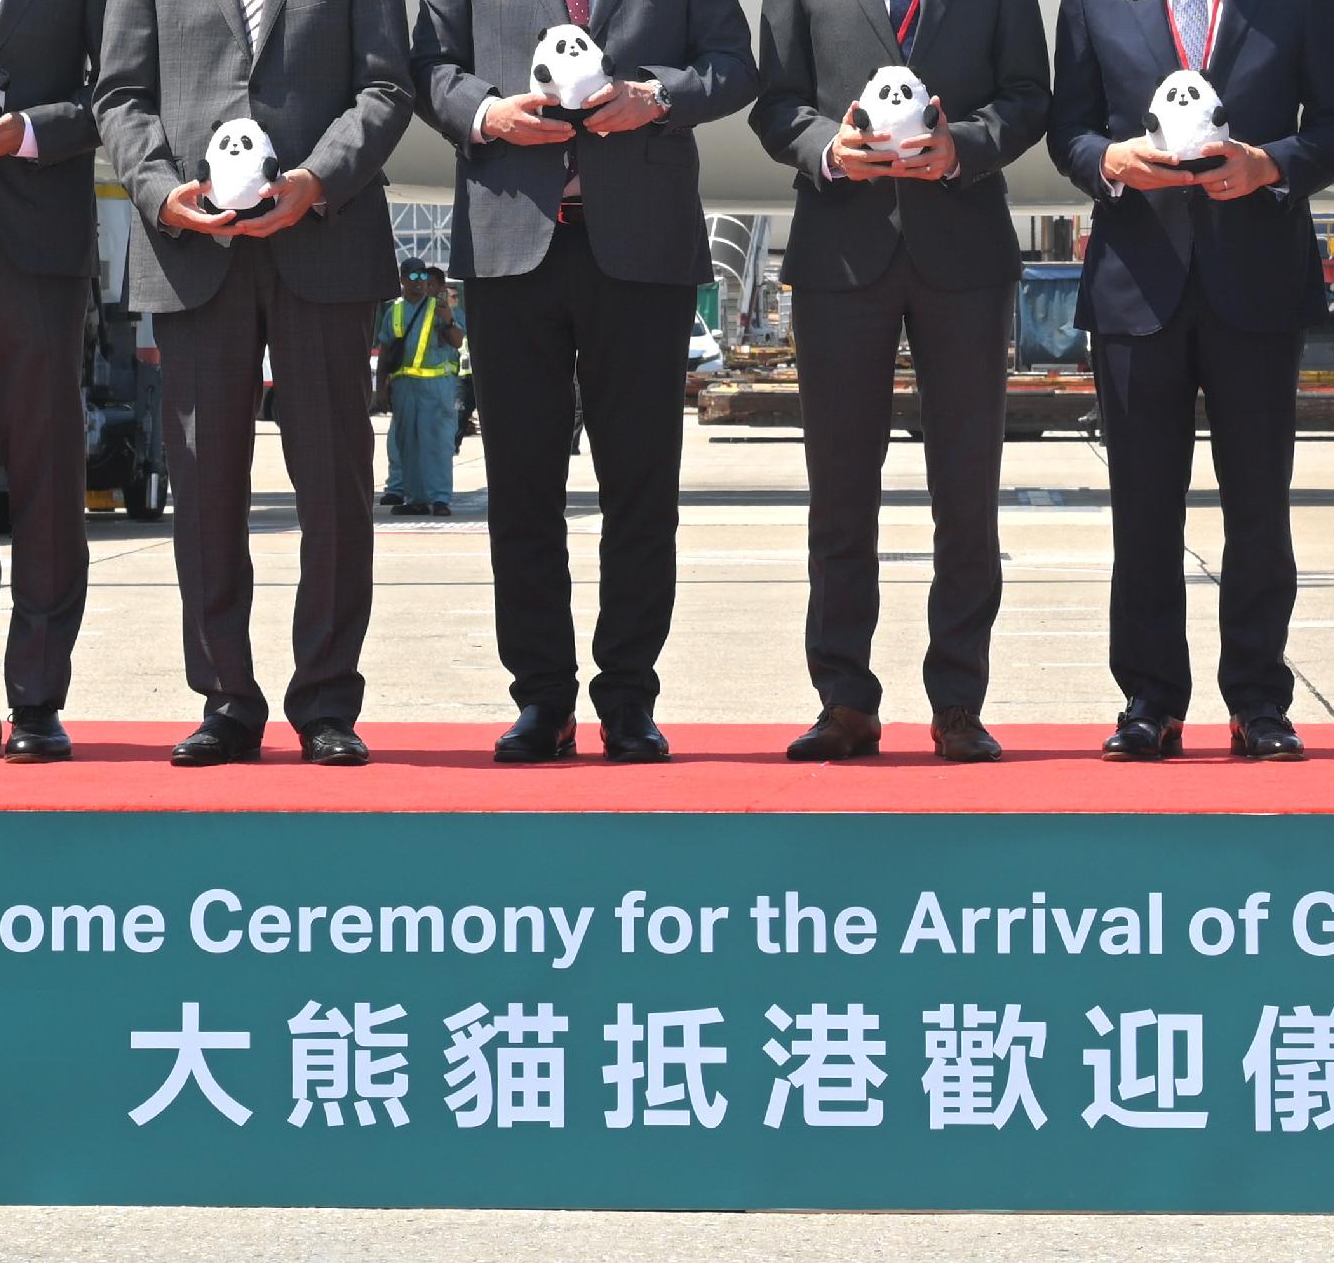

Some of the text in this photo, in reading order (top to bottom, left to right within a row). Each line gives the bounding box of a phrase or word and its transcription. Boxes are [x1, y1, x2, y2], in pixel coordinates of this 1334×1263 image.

[190, 888, 595, 969] Ceremony
[614, 890, 730, 955] for
[750, 891, 878, 955] the
[900, 891, 1163, 956] Arrival
[1188, 891, 1271, 957] of
